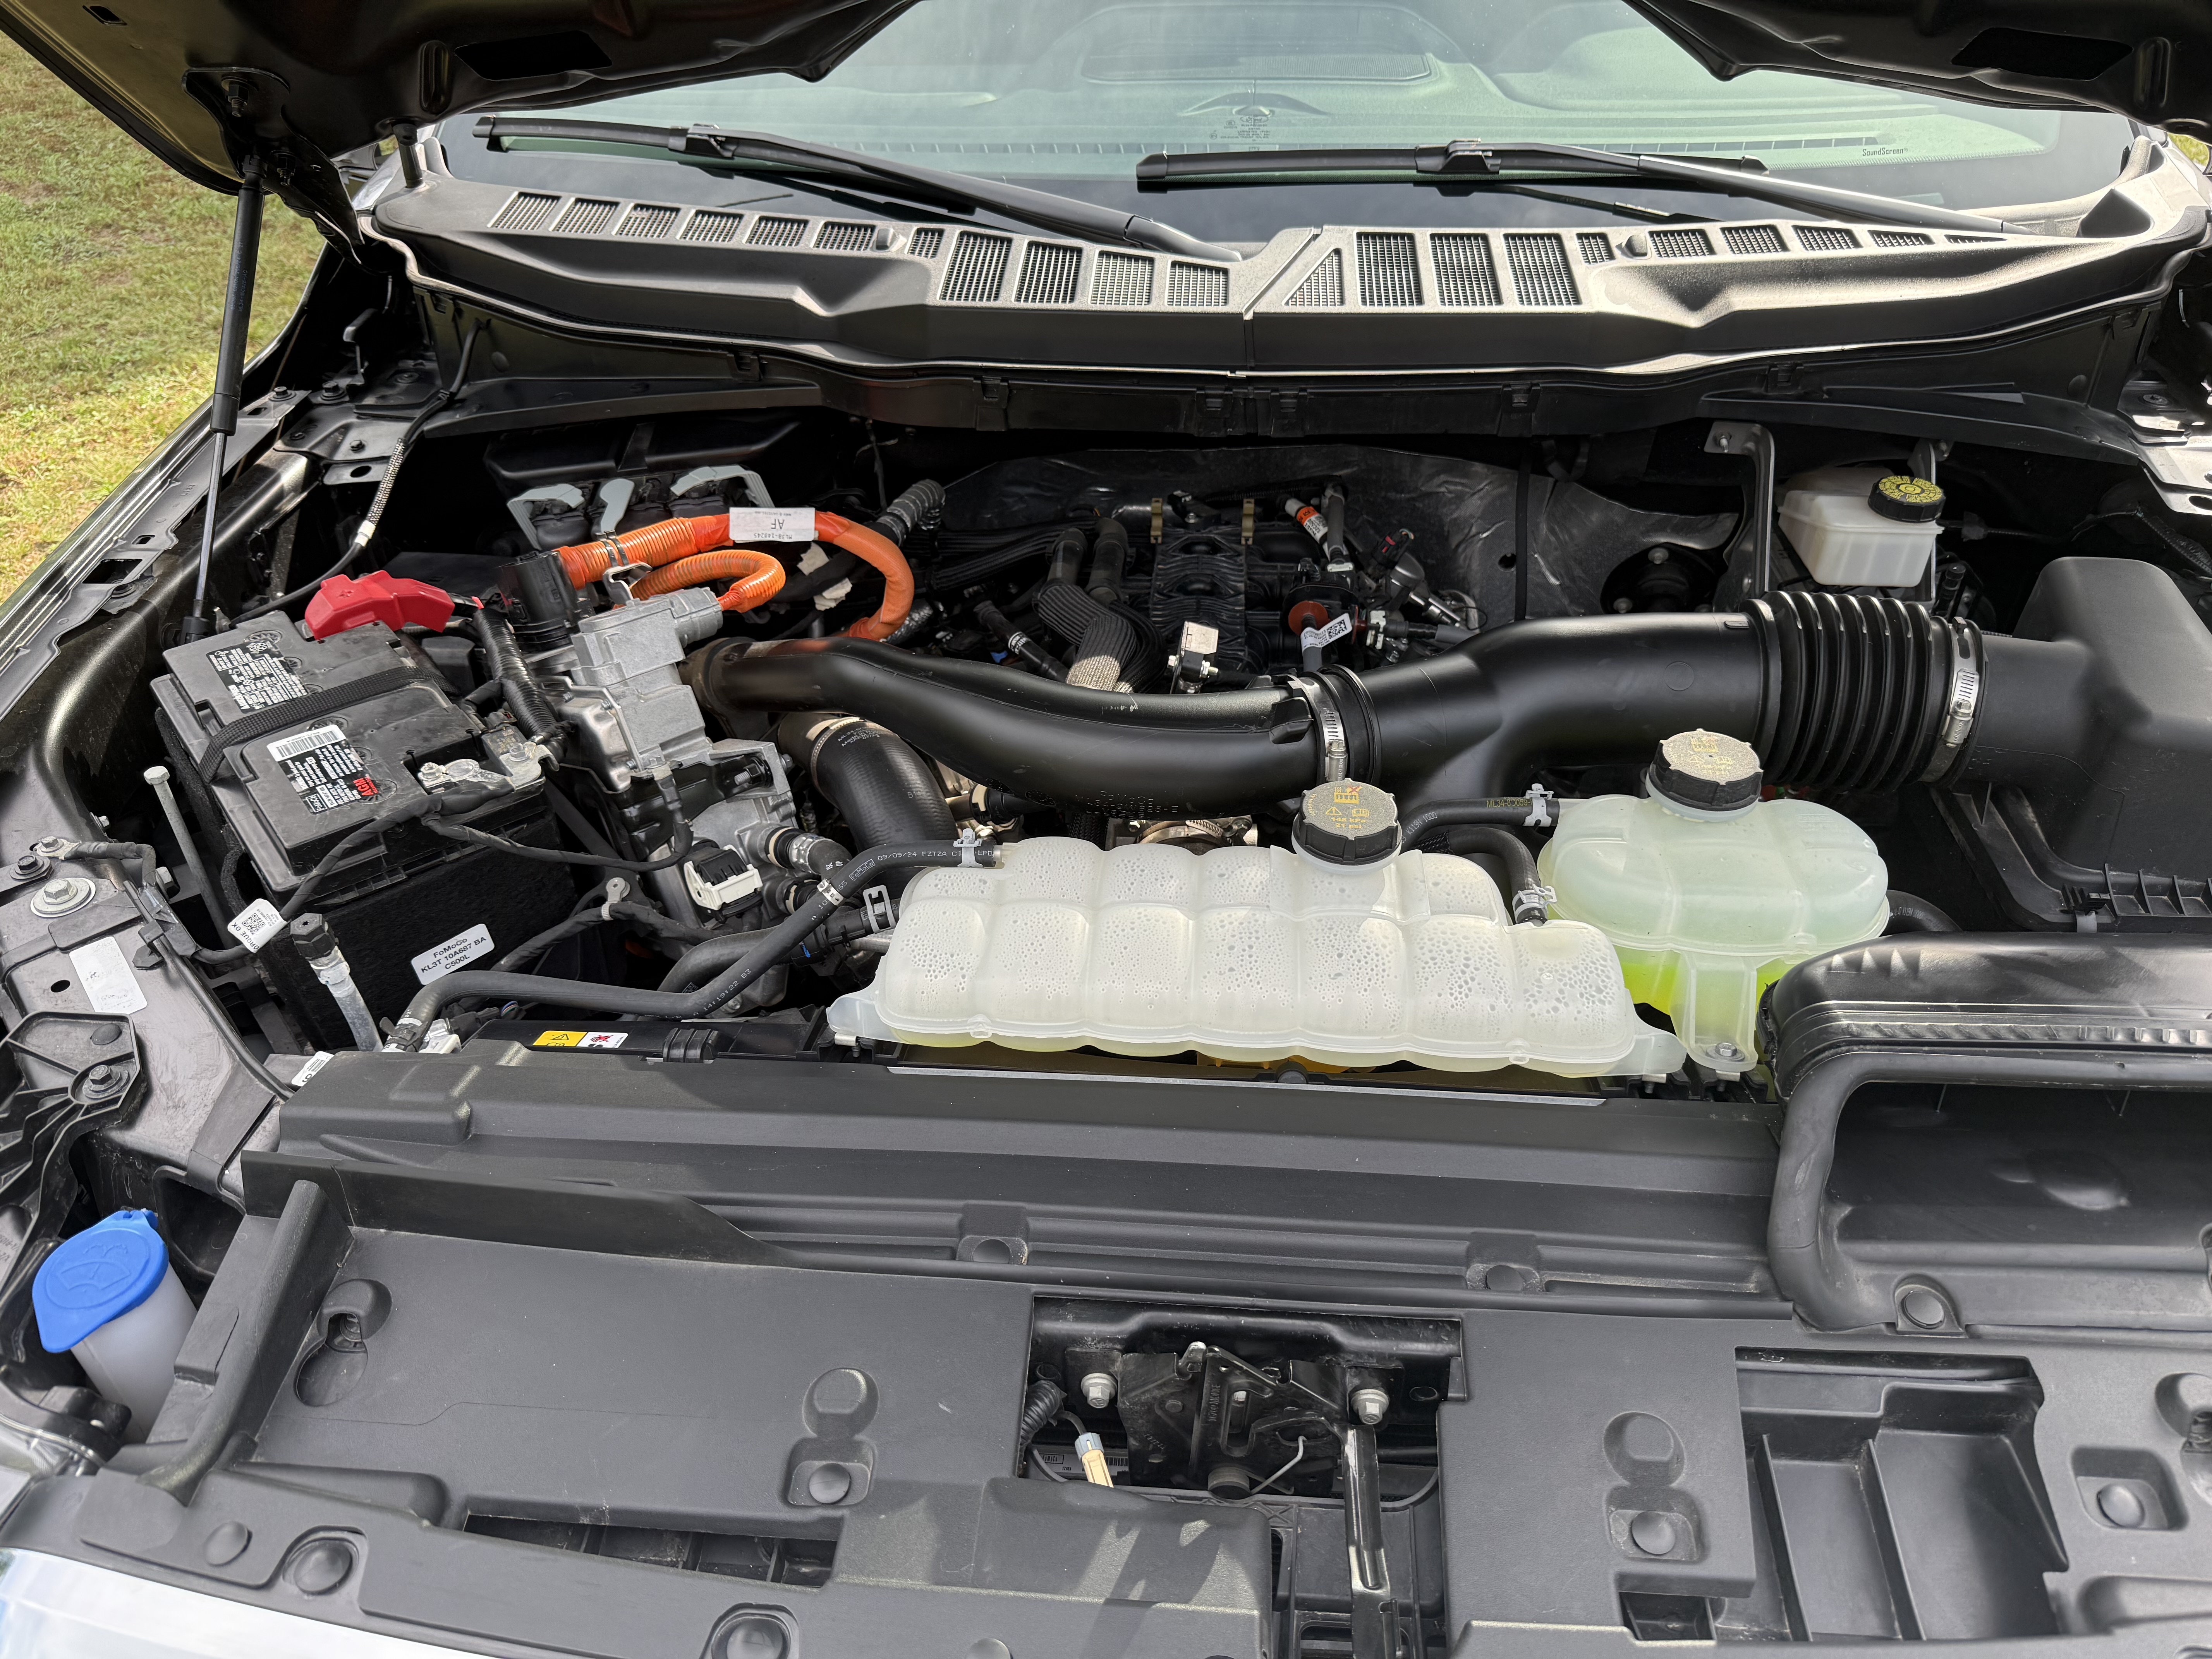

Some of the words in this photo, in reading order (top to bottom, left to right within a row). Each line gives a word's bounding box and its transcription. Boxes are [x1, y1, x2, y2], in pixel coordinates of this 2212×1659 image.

[771, 519, 785, 530] AF
[352, 777, 374, 797] AGM
[851, 862, 874, 880] FoMoCo
[878, 851, 917, 861] 09/09/24
[231, 922, 241, 931] OK
[240, 931, 259, 950] ORQUE
[433, 938, 468, 958] FoMoCo
[421, 958, 442, 973] KL3T
[474, 936, 487, 946] BA
[444, 954, 471, 970] C500L
[740, 969, 752, 979] B3
